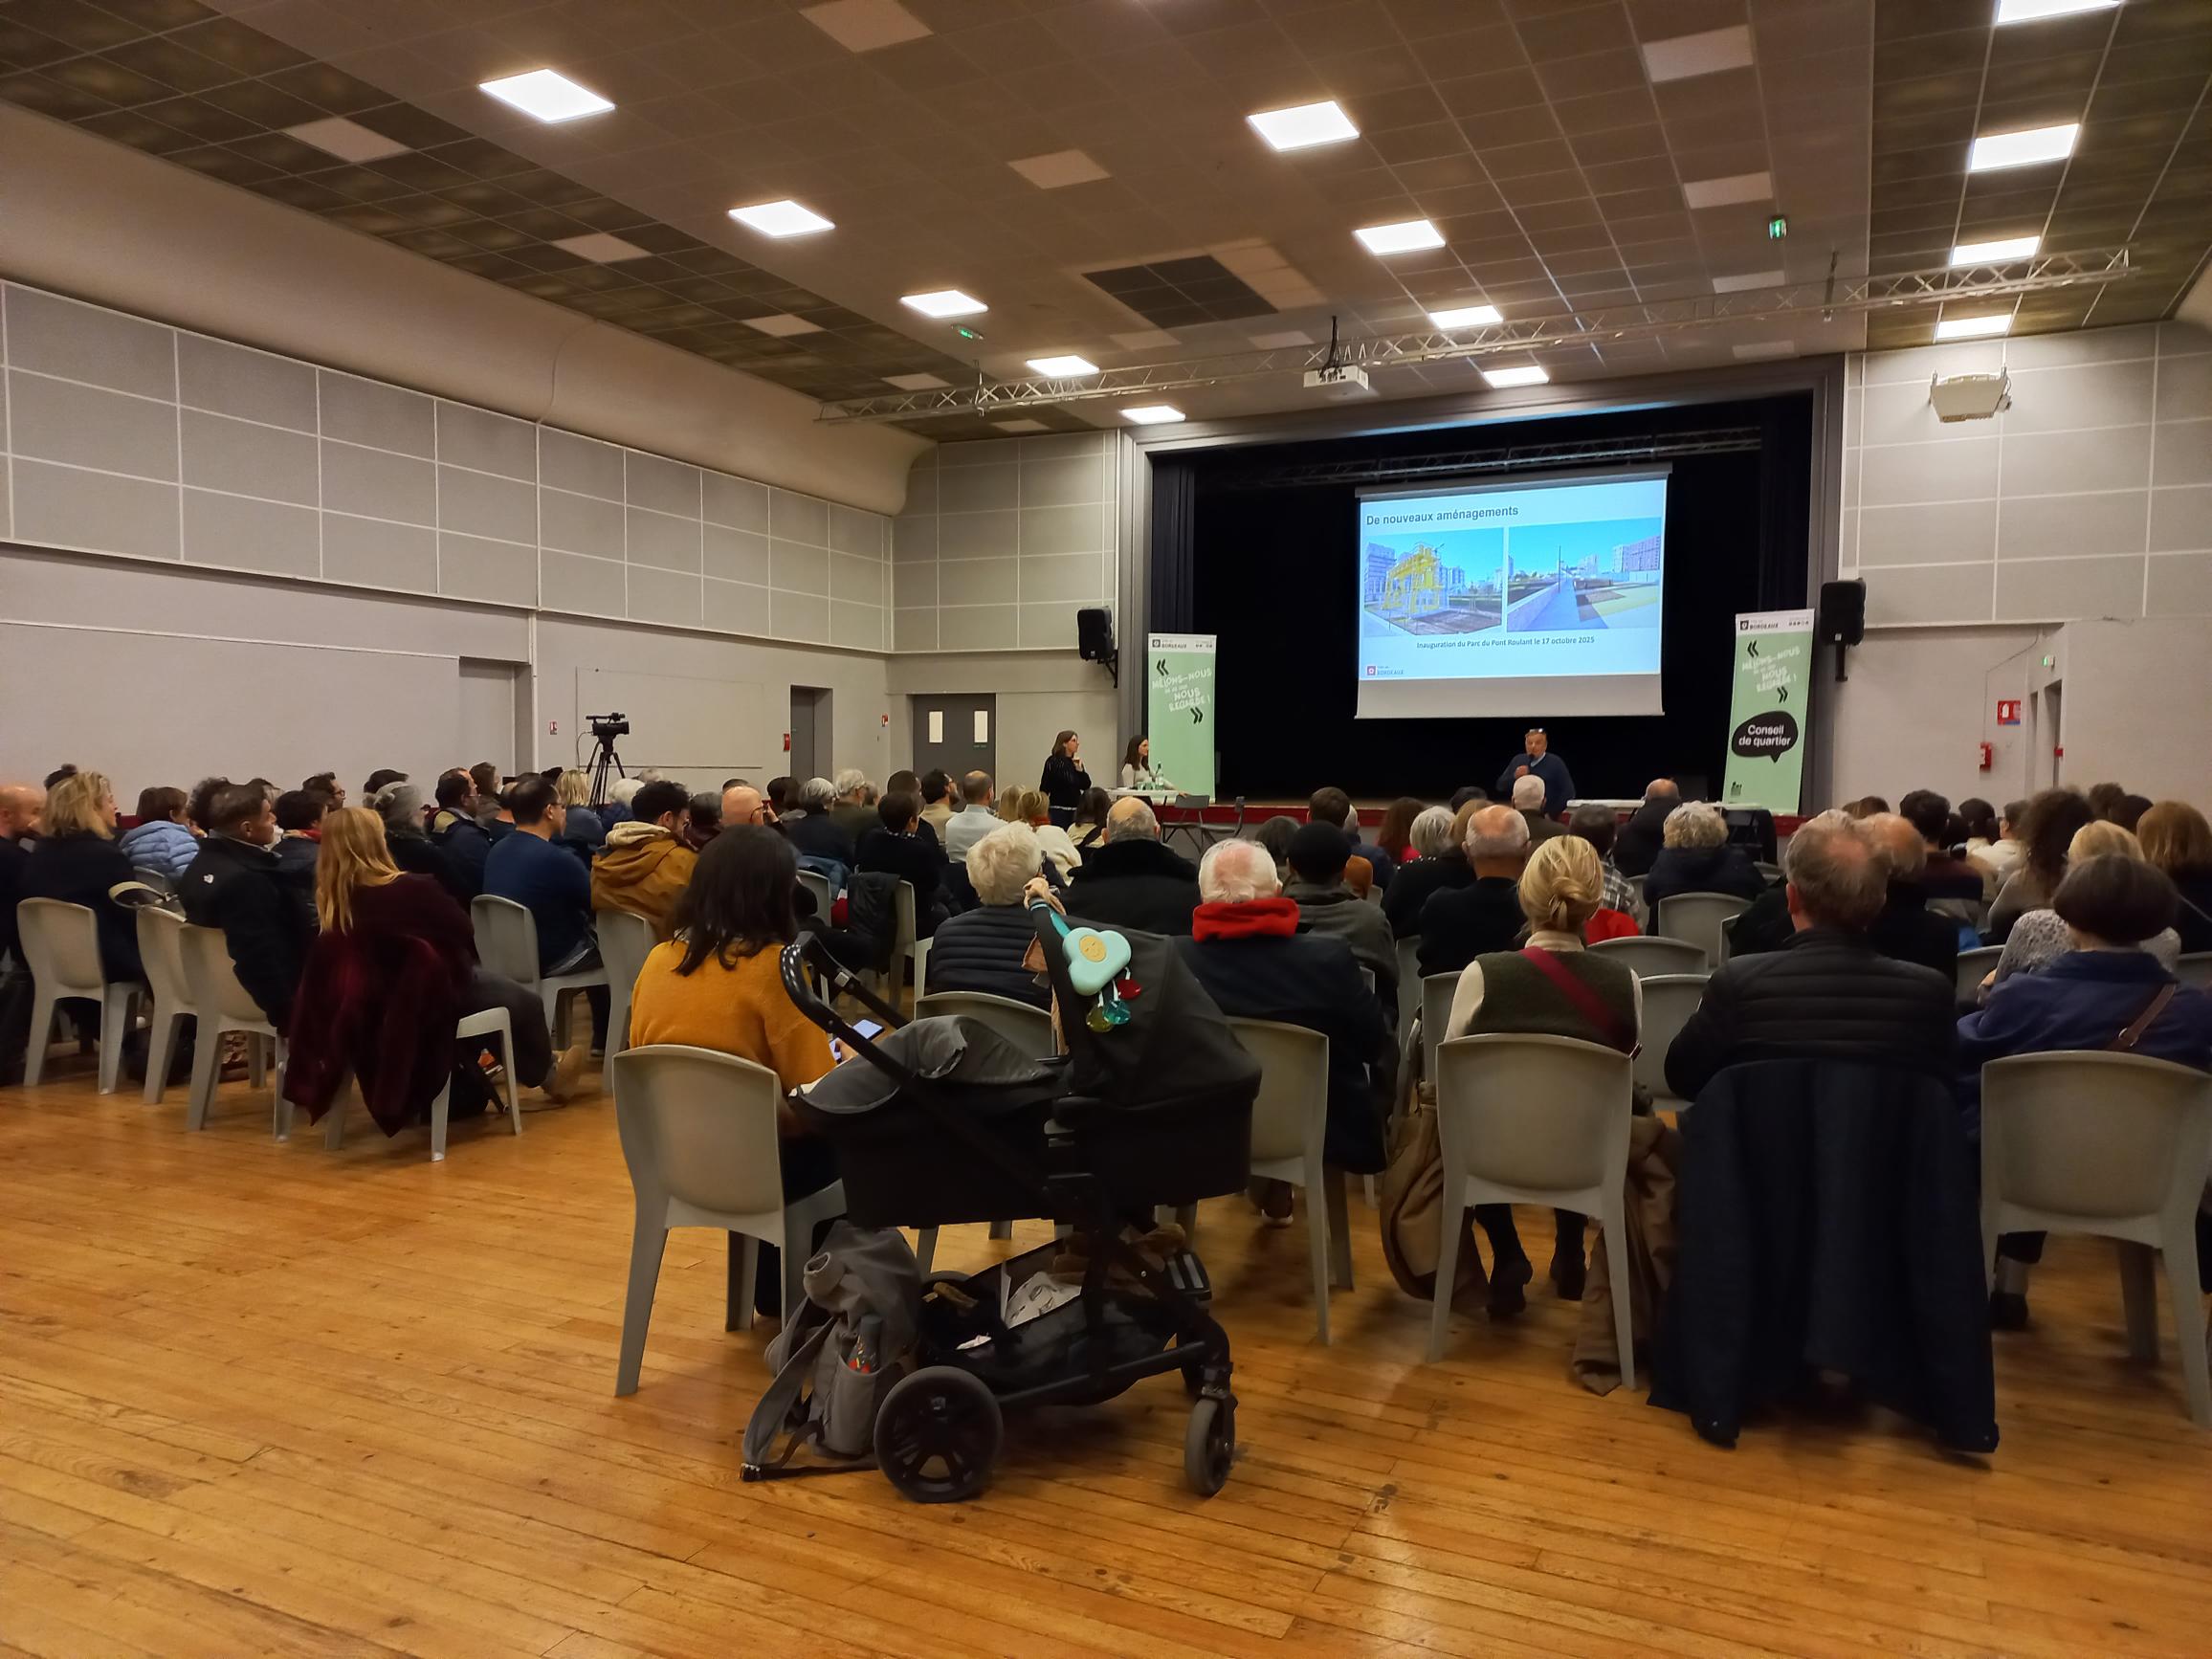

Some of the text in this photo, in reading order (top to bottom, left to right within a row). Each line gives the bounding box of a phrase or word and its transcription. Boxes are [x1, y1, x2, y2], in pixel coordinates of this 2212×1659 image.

[1366, 505, 1519, 525] De nouveaux aménagements
[1416, 640, 1456, 650] Inauguration
[1507, 638, 1533, 647] Roulant
[1534, 637, 1540, 646] le
[1541, 637, 1551, 646] 17
[1551, 636, 1577, 646] octobre
[1578, 635, 1595, 644] 2025
[1174, 687, 1201, 701] NOUS
[1747, 724, 1785, 736] Conseil
[1738, 736, 1792, 748] de quartier
